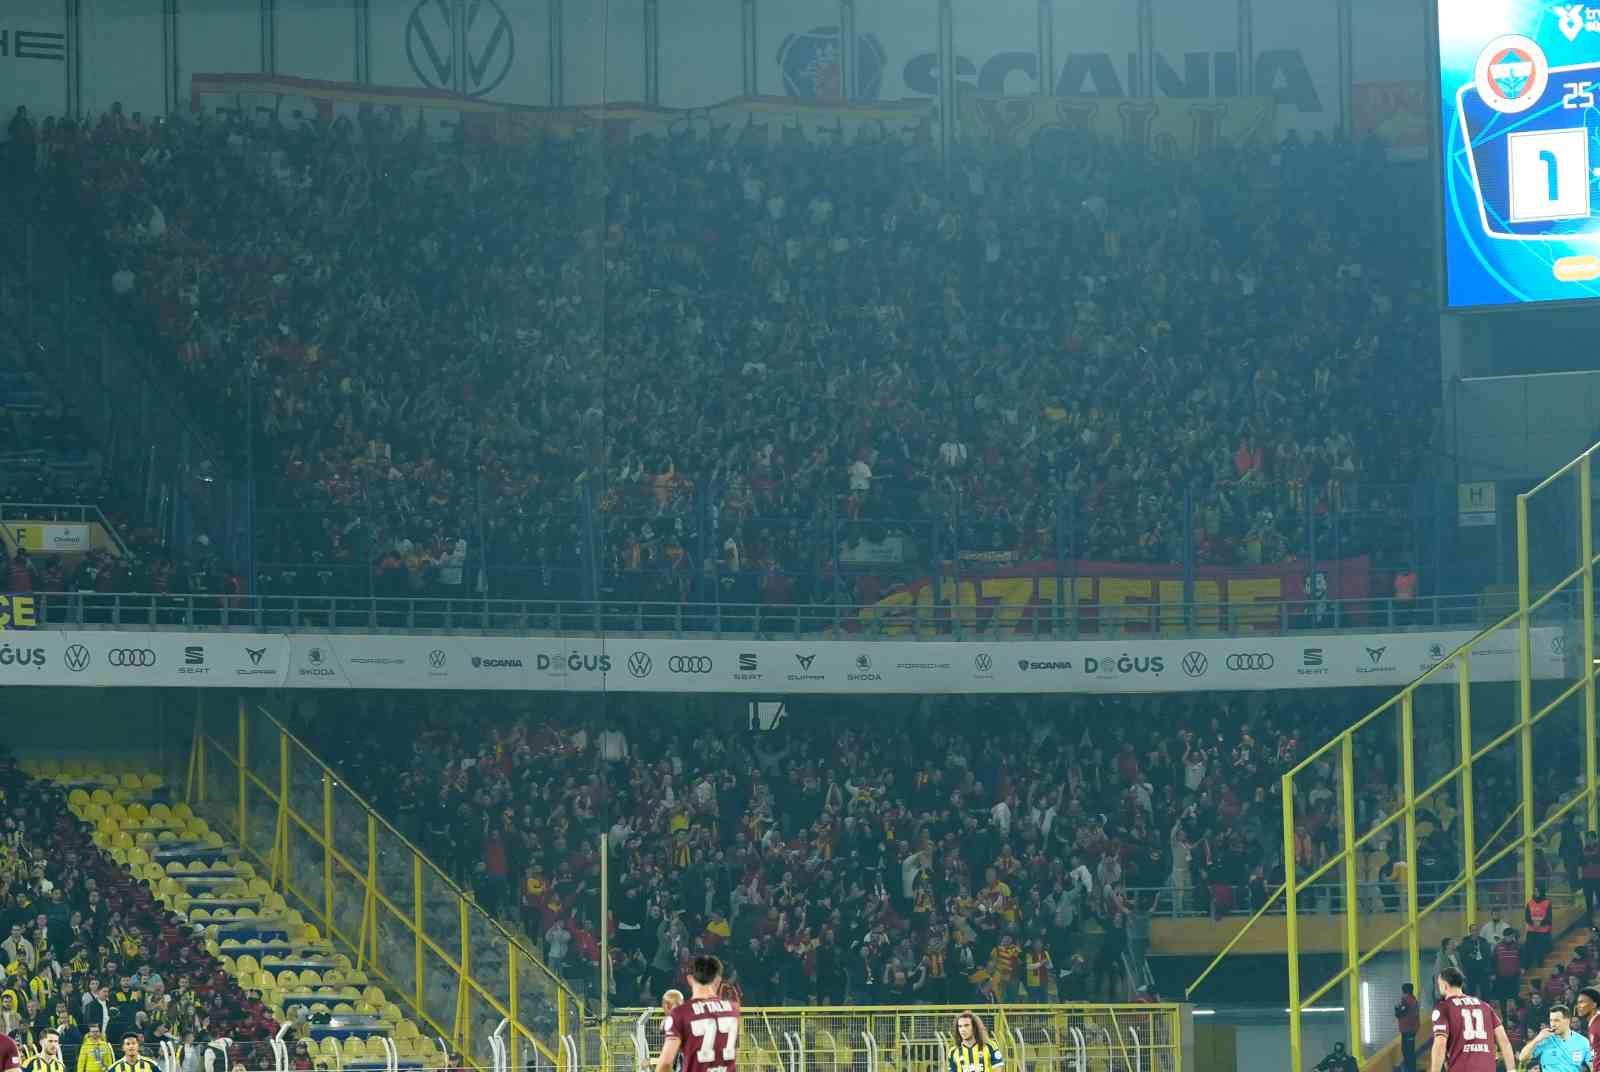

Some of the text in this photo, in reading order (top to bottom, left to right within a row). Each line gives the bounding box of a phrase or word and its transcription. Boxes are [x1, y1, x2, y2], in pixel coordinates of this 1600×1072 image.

[0, 30, 65, 60] E
[903, 50, 1323, 112] SCANIA
[1563, 81, 1594, 109] 25
[1539, 149, 1560, 201] 1
[482, 659, 523, 668] SCANIA
[690, 1016, 738, 1063] 77
[1461, 1008, 1488, 1041] 11
